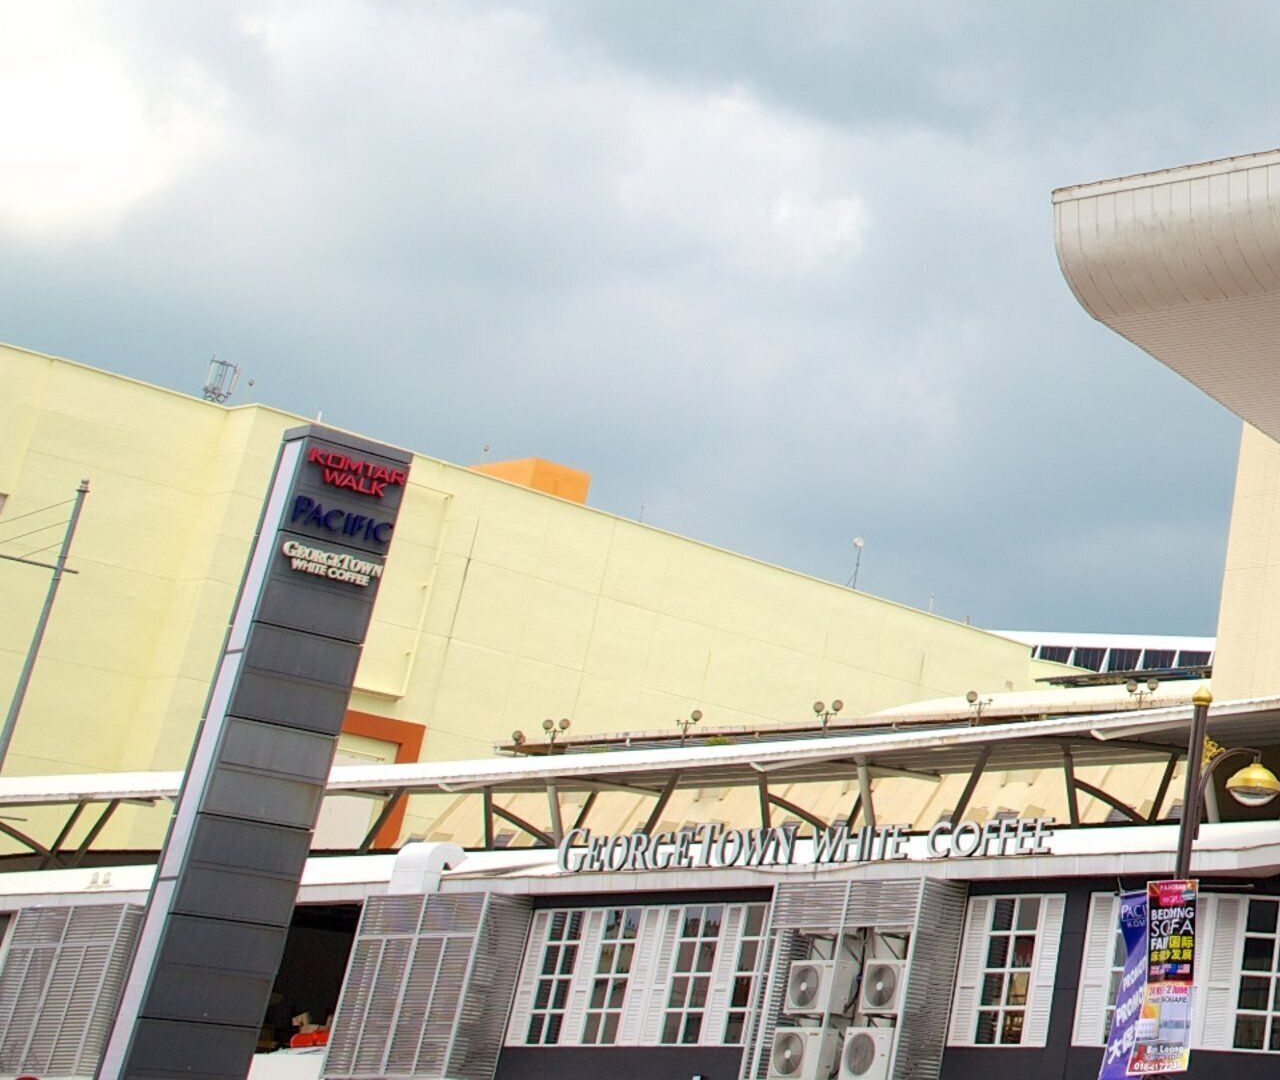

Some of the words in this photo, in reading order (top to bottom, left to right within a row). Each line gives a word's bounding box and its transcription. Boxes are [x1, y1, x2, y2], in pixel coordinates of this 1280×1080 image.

[308, 447, 407, 486] KOMTAR
[322, 468, 388, 498] WALK
[291, 495, 395, 543] PACIFIC
[291, 557, 327, 576] WHITE
[327, 567, 370, 587] COFFEE
[812, 823, 912, 863] WHITE
[926, 817, 1056, 858] COFFEE
[1151, 919, 1194, 937] SOFA
